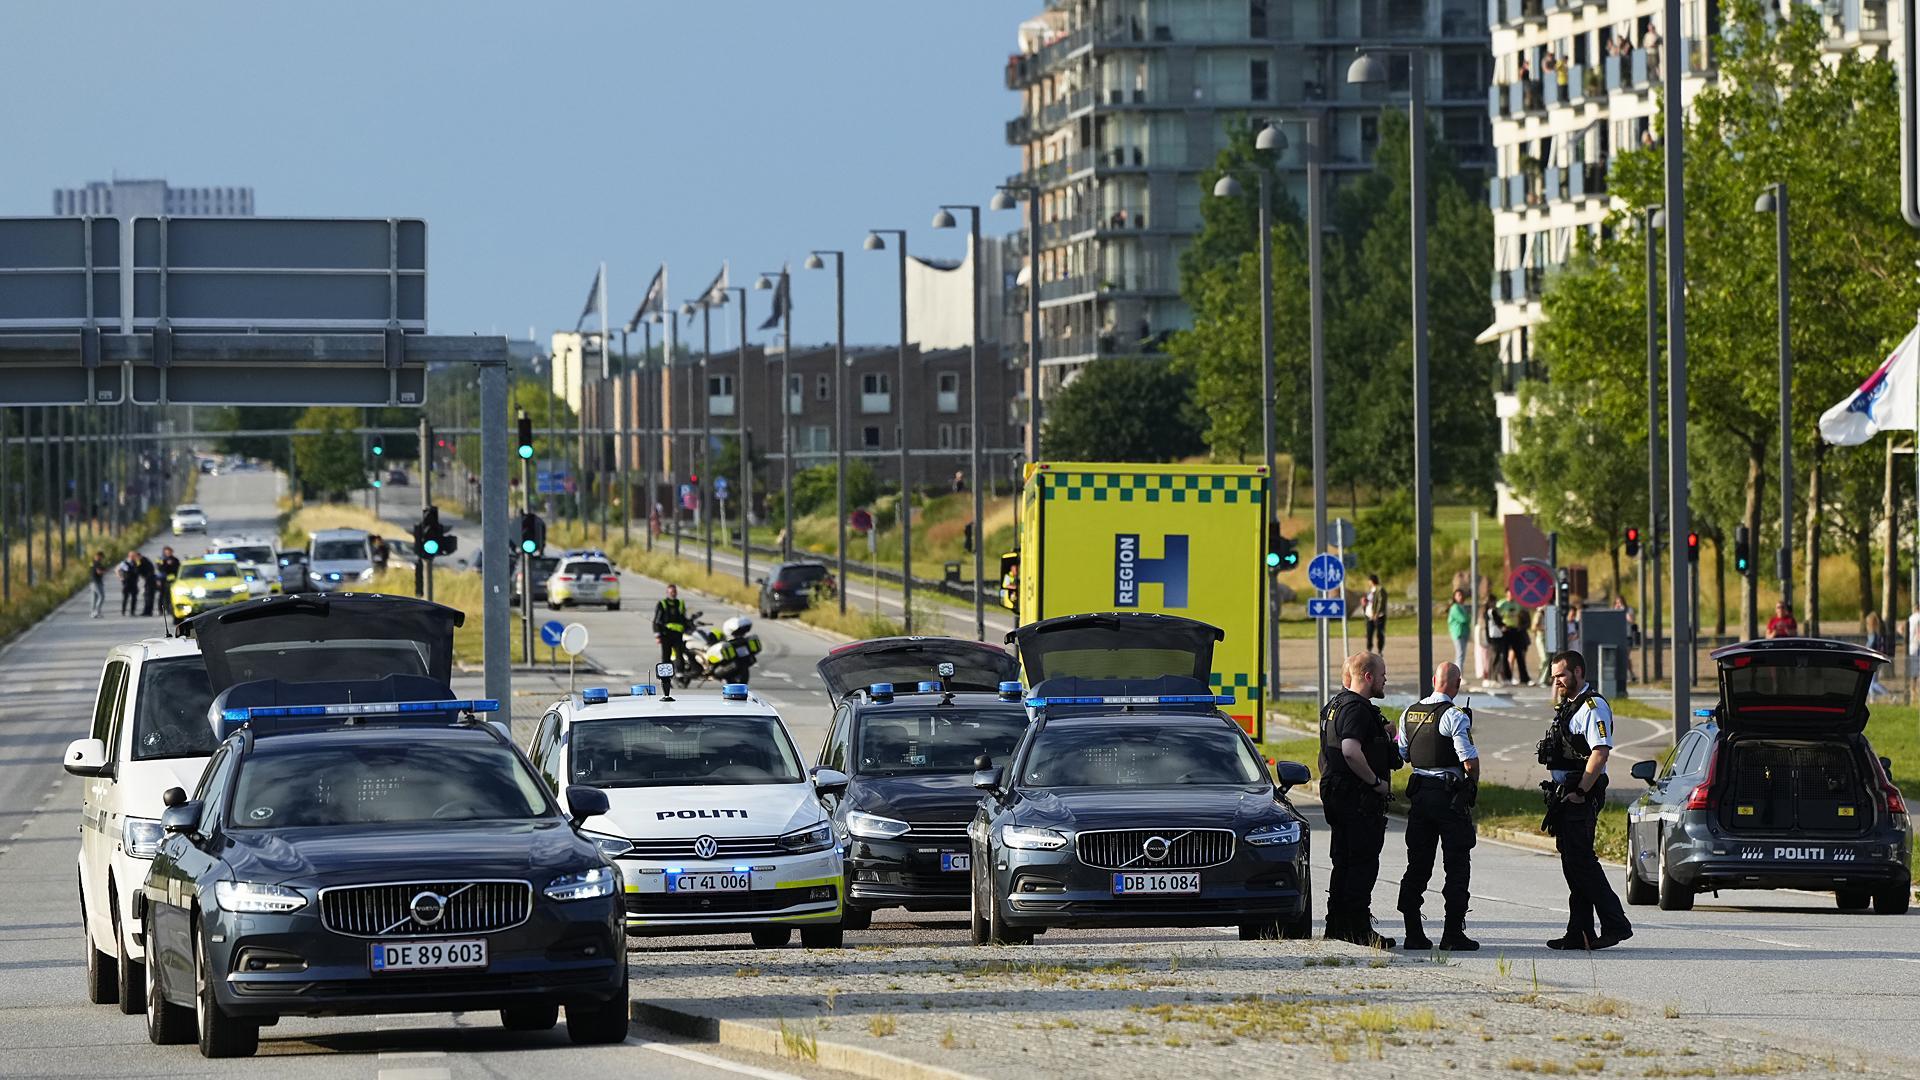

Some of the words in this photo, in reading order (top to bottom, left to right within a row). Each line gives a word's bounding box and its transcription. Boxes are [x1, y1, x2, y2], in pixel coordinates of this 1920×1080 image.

[1114, 534, 1189, 608] H
[1119, 537, 1134, 603] REGION
[655, 809, 748, 821] POLITI
[1774, 847, 1825, 860] POLITI
[951, 856, 969, 868] CT
[677, 876, 697, 890] CT
[700, 876, 716, 889] 41
[720, 875, 747, 889] 006
[1124, 876, 1145, 890] DB
[1150, 876, 1167, 890] 16
[1170, 875, 1198, 890] 084
[386, 947, 413, 966] DE
[418, 945, 443, 965] 89
[447, 944, 483, 963] 603
